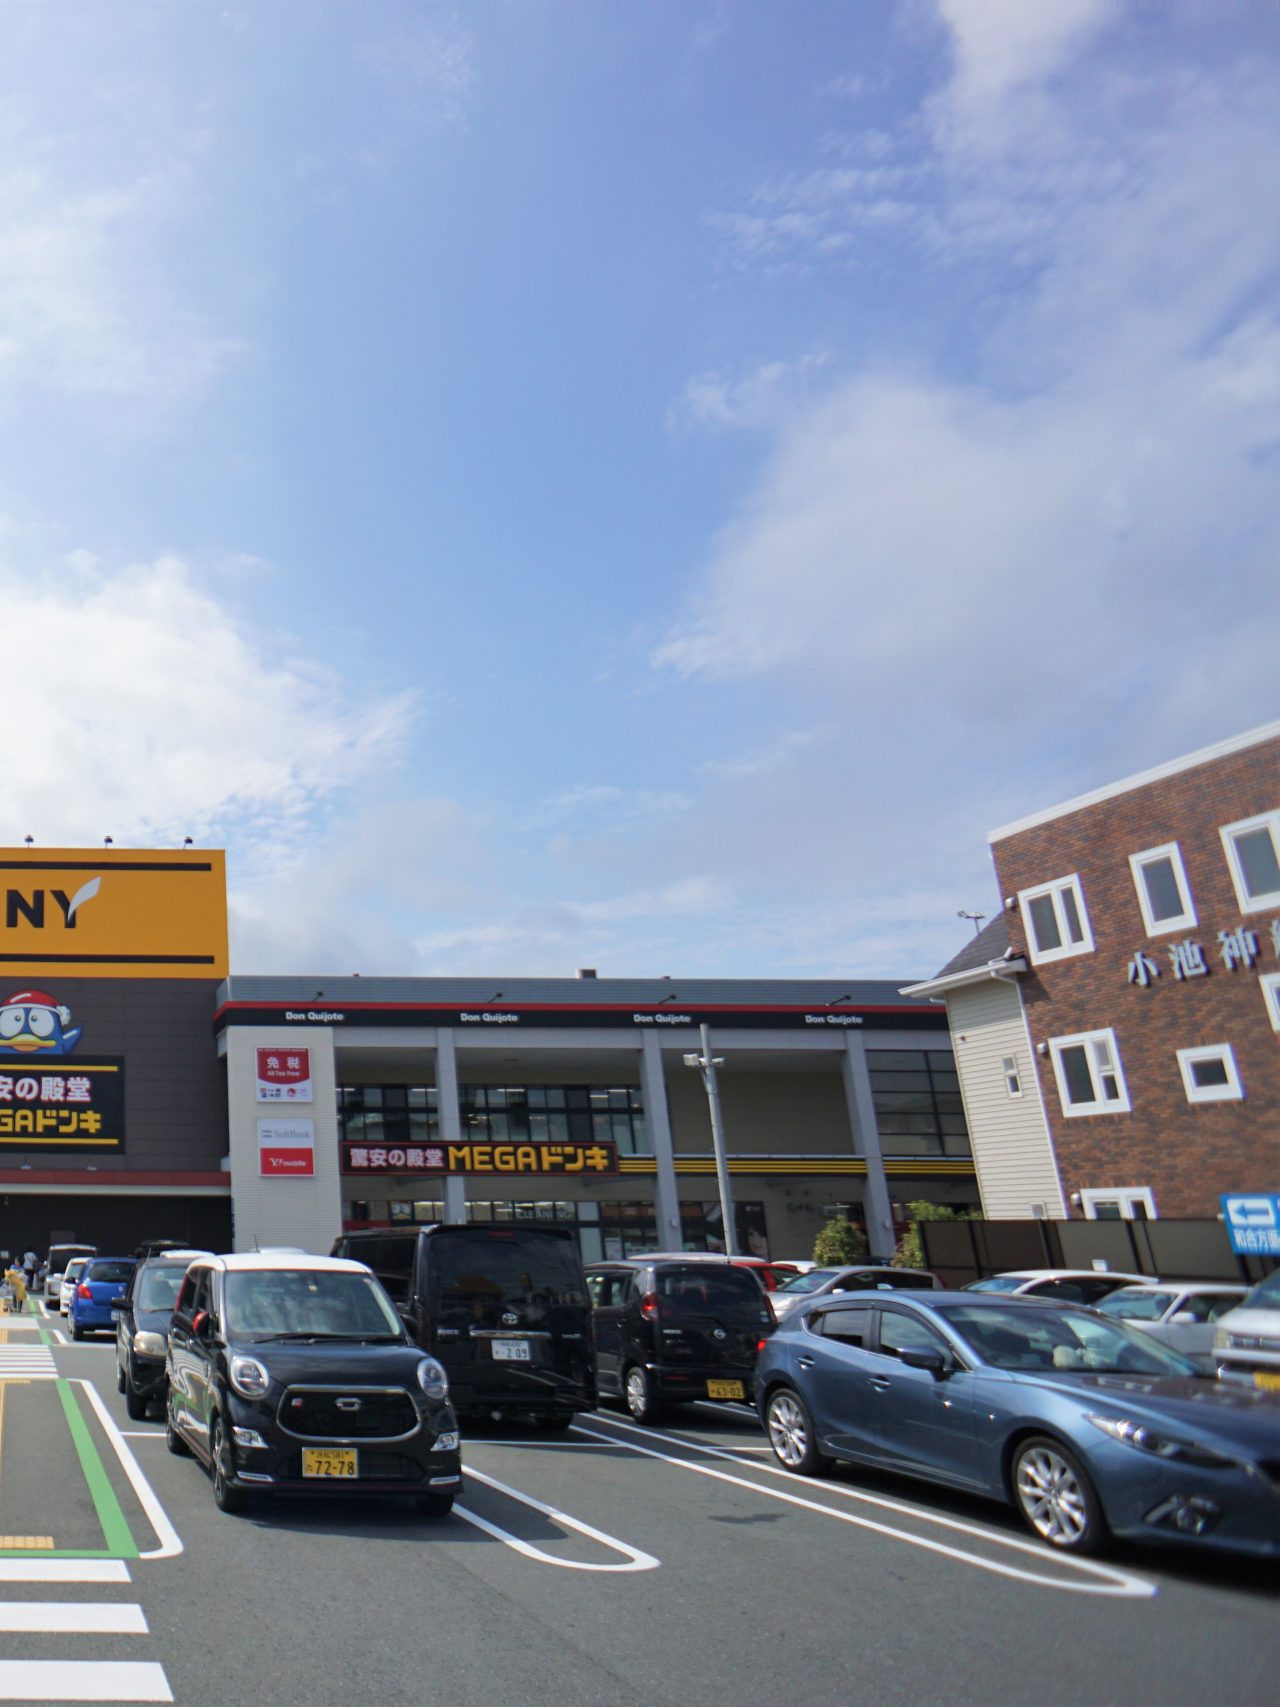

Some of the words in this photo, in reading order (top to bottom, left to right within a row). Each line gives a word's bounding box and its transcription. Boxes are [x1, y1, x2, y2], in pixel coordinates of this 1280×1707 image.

[1127, 920, 1280, 987] 小池神
[285, 1011, 305, 1020] Don
[307, 1012, 344, 1022] Quijote
[460, 1012, 480, 1022] Don
[482, 1013, 518, 1023] Quijote
[633, 1013, 653, 1023] Don
[655, 1014, 691, 1025] Quijote
[805, 1015, 825, 1024] Don
[826, 1015, 863, 1025] Quijote
[266, 1056, 300, 1069] 免税
[273, 1129, 311, 1137] SoftBank
[350, 1148, 444, 1167] 驚安の殿堂
[448, 1146, 609, 1171] MEGAドンキ
[315, 1460, 355, 1476] 72-78
